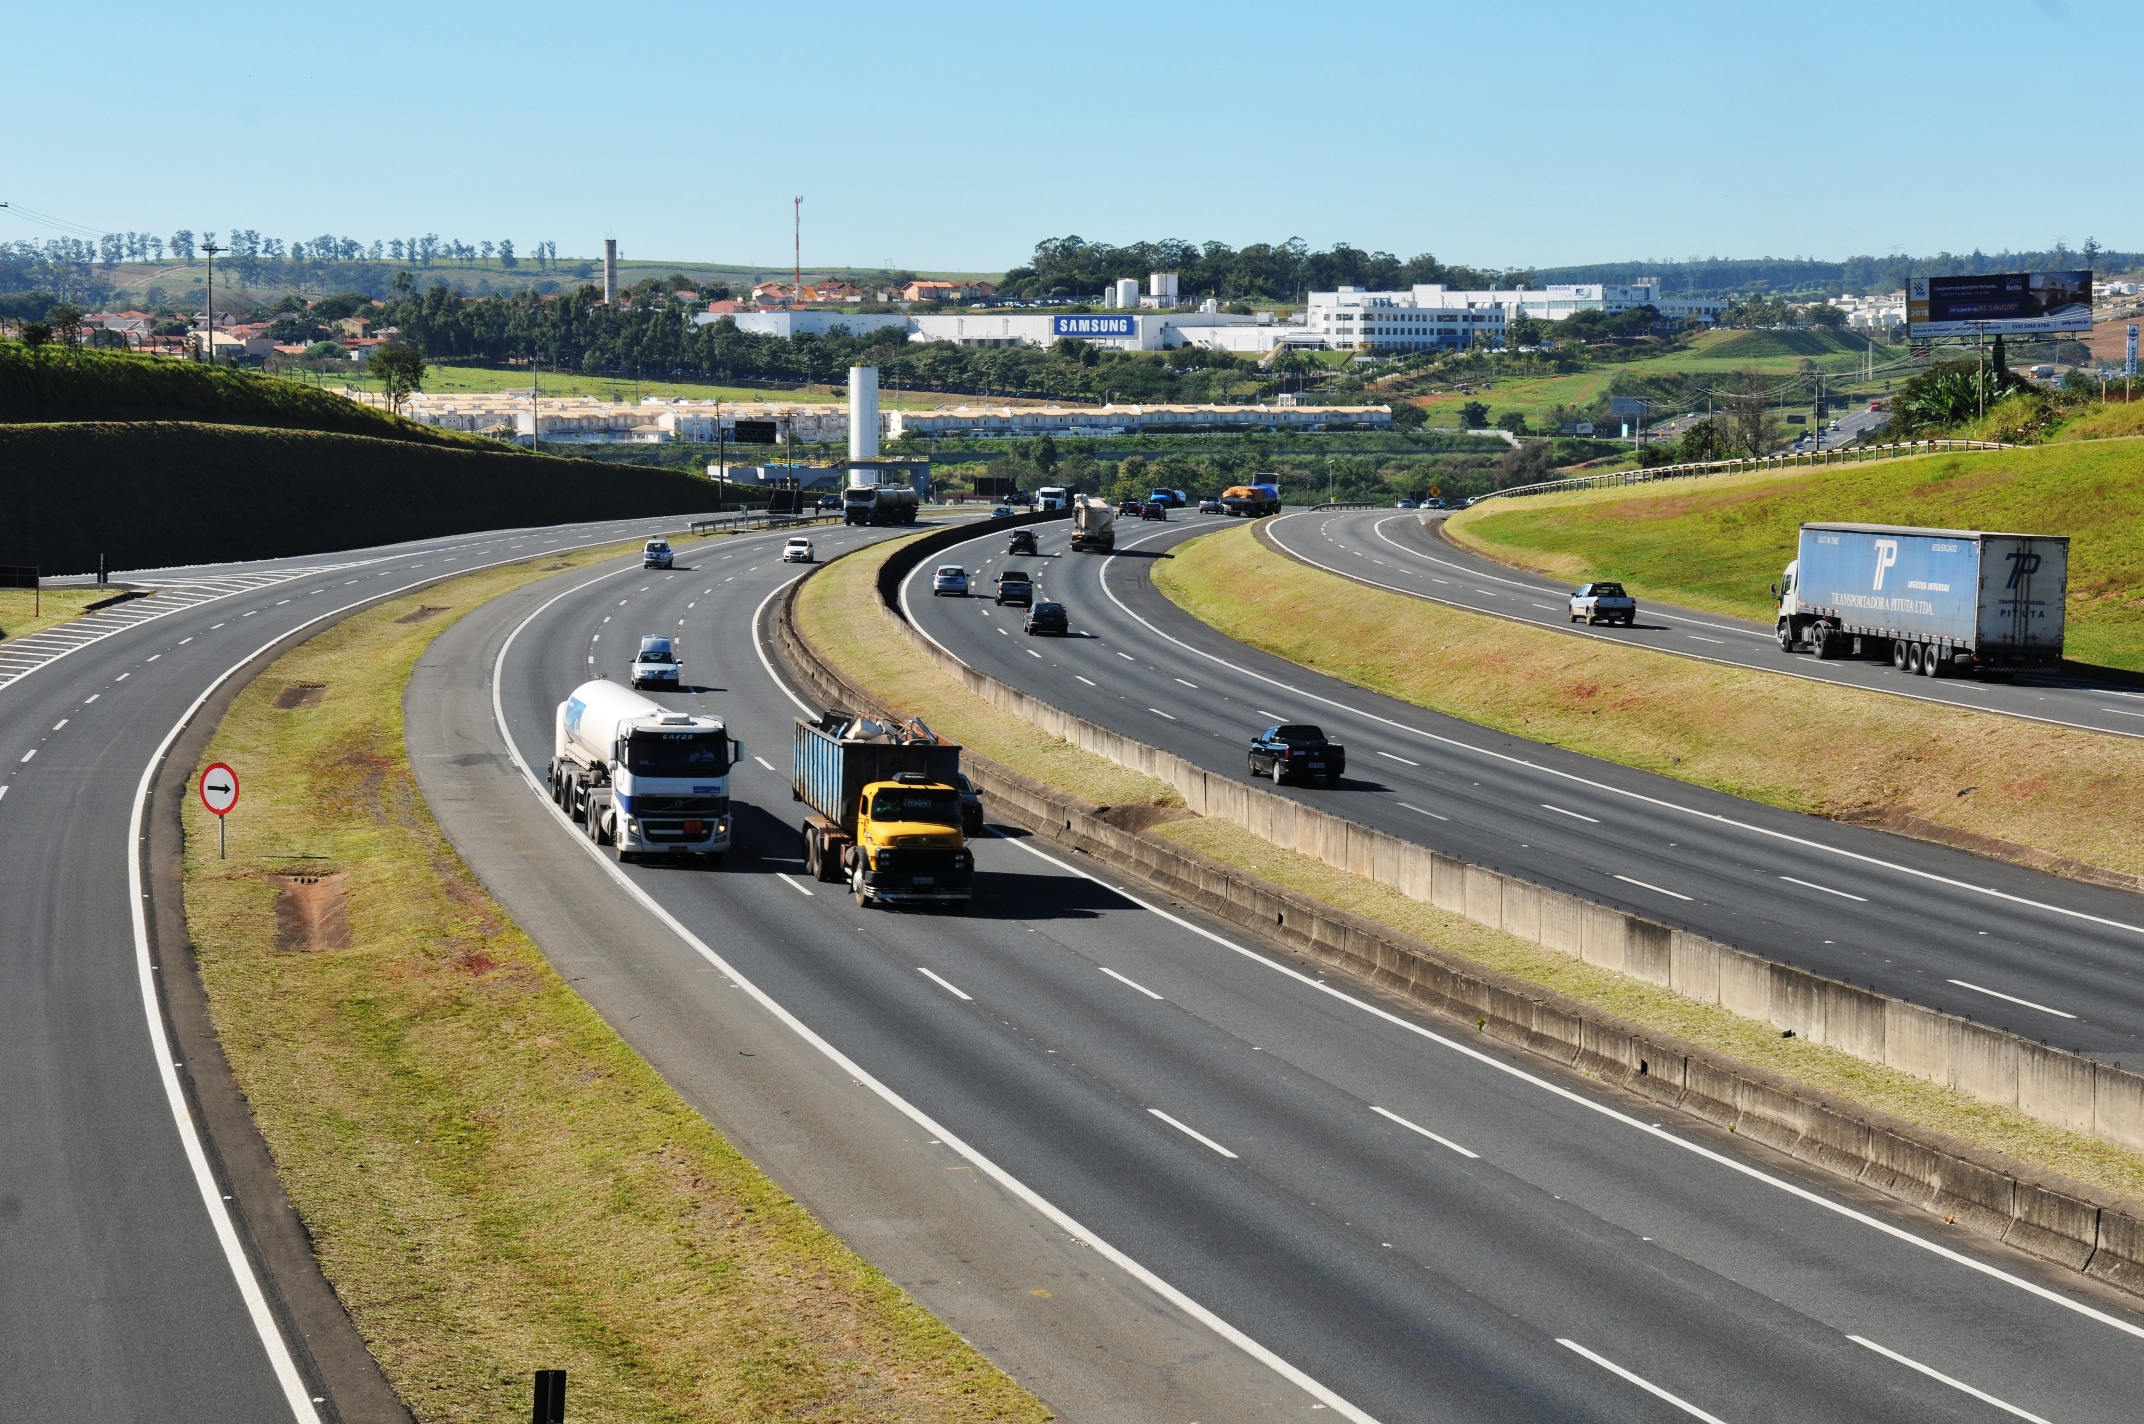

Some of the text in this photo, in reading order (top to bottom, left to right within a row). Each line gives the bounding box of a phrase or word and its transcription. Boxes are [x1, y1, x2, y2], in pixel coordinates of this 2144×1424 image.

[1978, 304, 1987, 312] R$
[1060, 319, 1127, 332] SAMSUNG
[1817, 536, 1826, 544] JUST
[1831, 592, 1934, 616] TRANSPORTADORA PITUTA LTDA.
[2000, 609, 2045, 618] PITUTA
